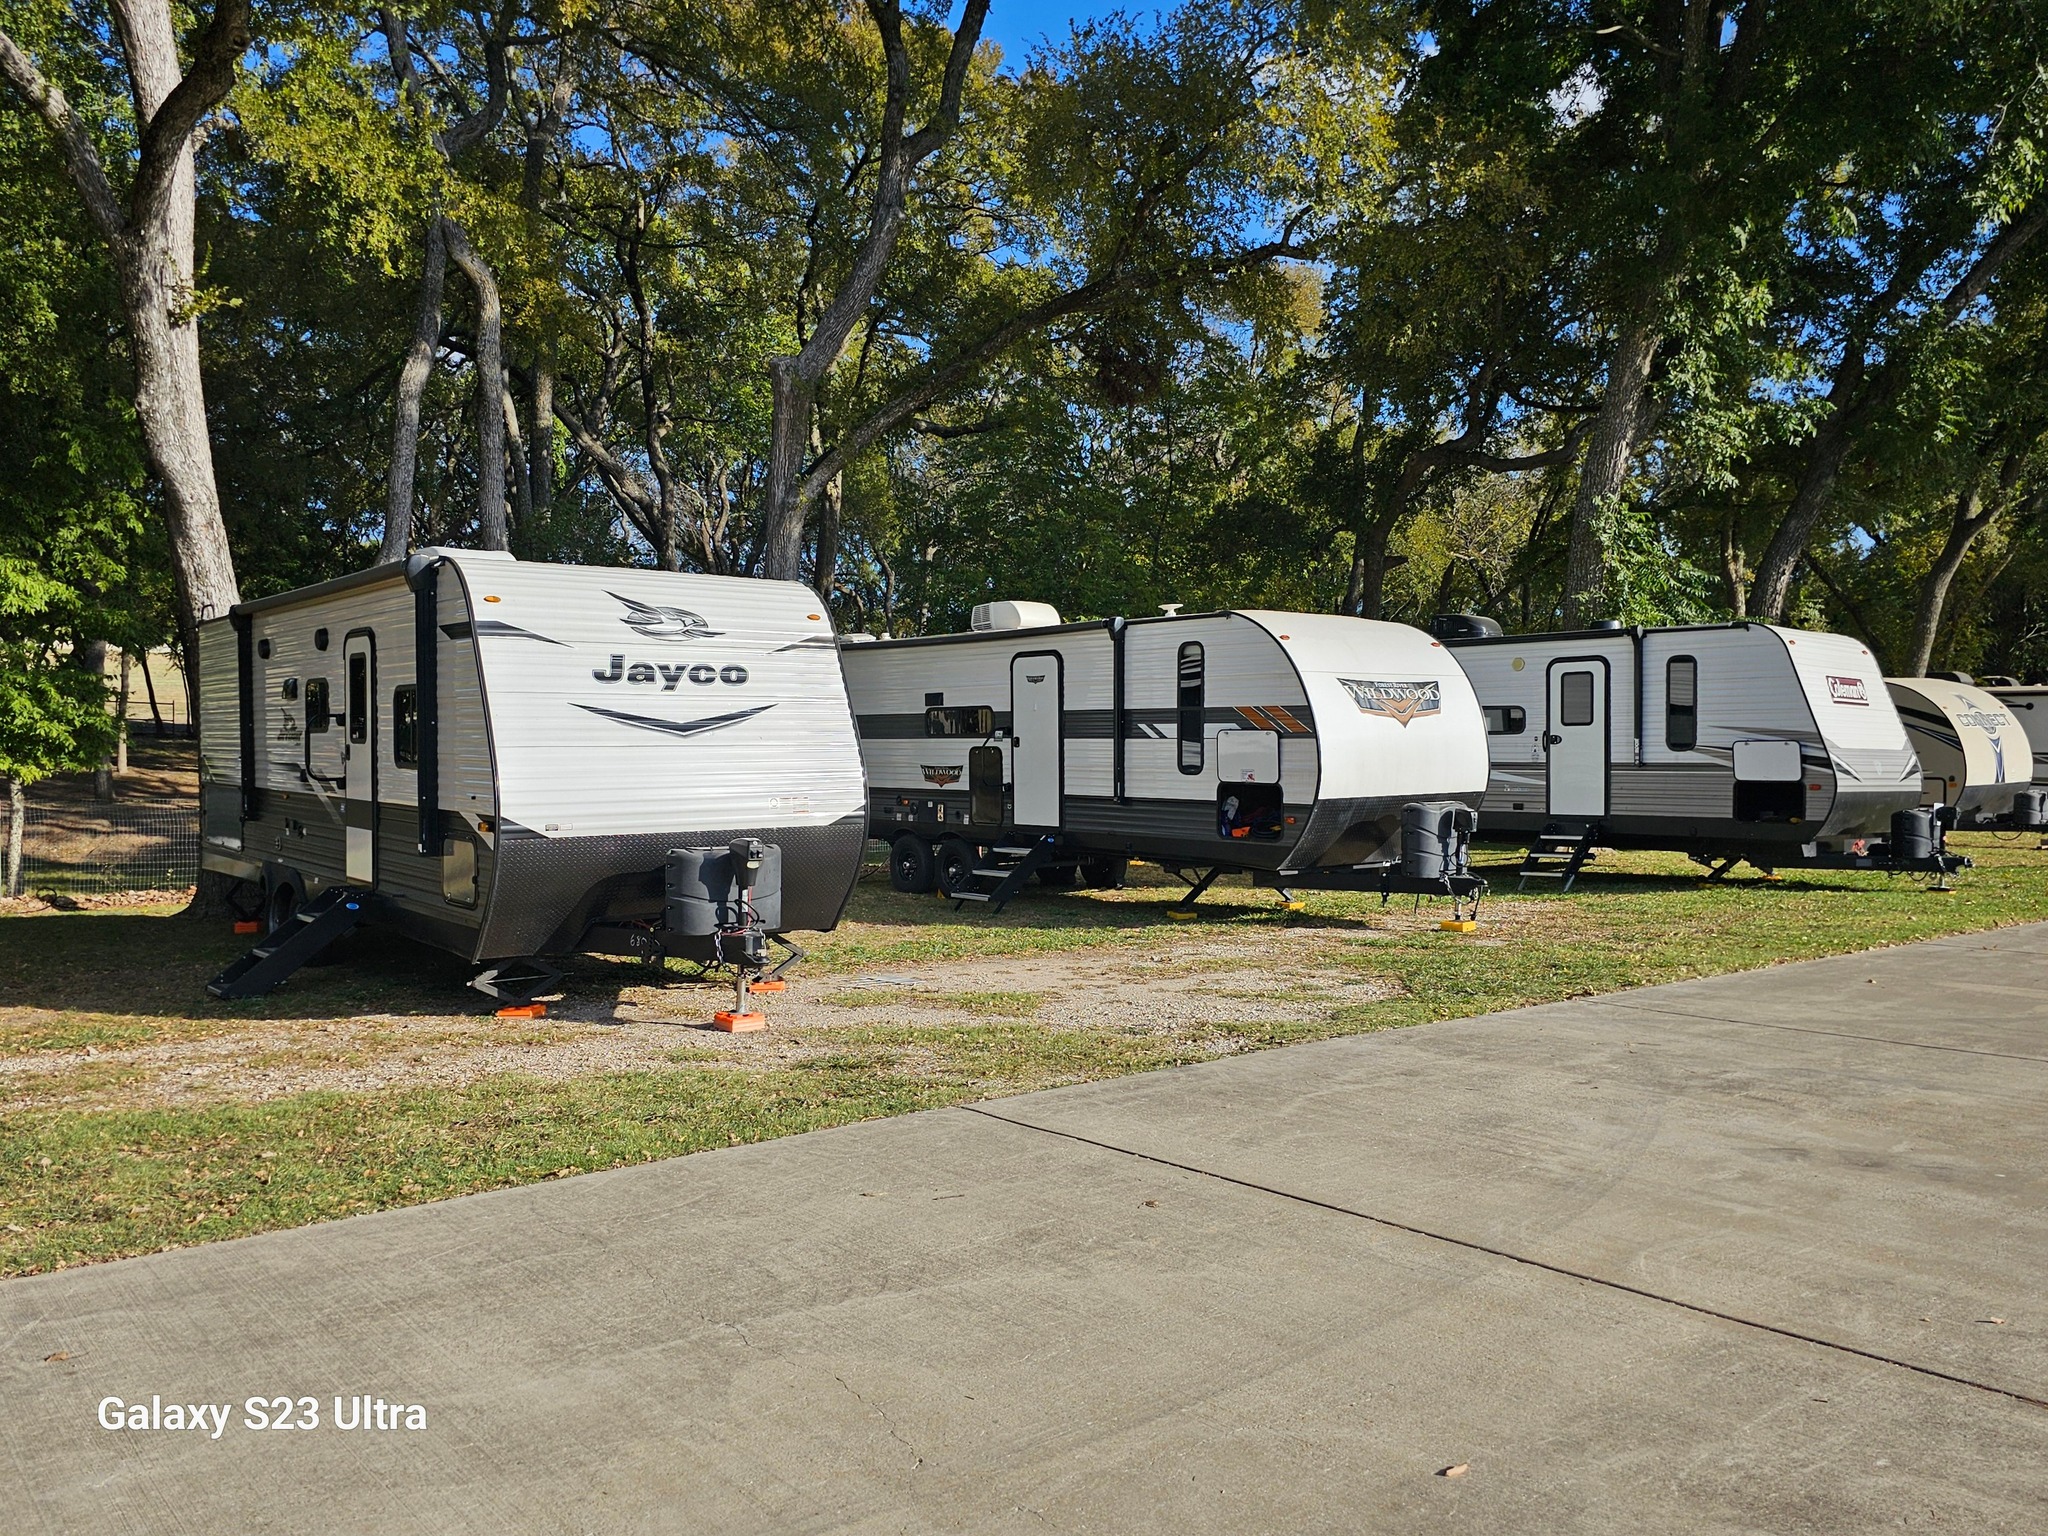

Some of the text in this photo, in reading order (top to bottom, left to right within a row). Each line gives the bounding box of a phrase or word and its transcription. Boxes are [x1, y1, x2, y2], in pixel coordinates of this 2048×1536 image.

[592, 654, 750, 692] Jayco
[1343, 685, 1440, 702] WILDWOOD
[1828, 677, 1861, 699] Coleman
[1956, 713, 2011, 727] CONNECT
